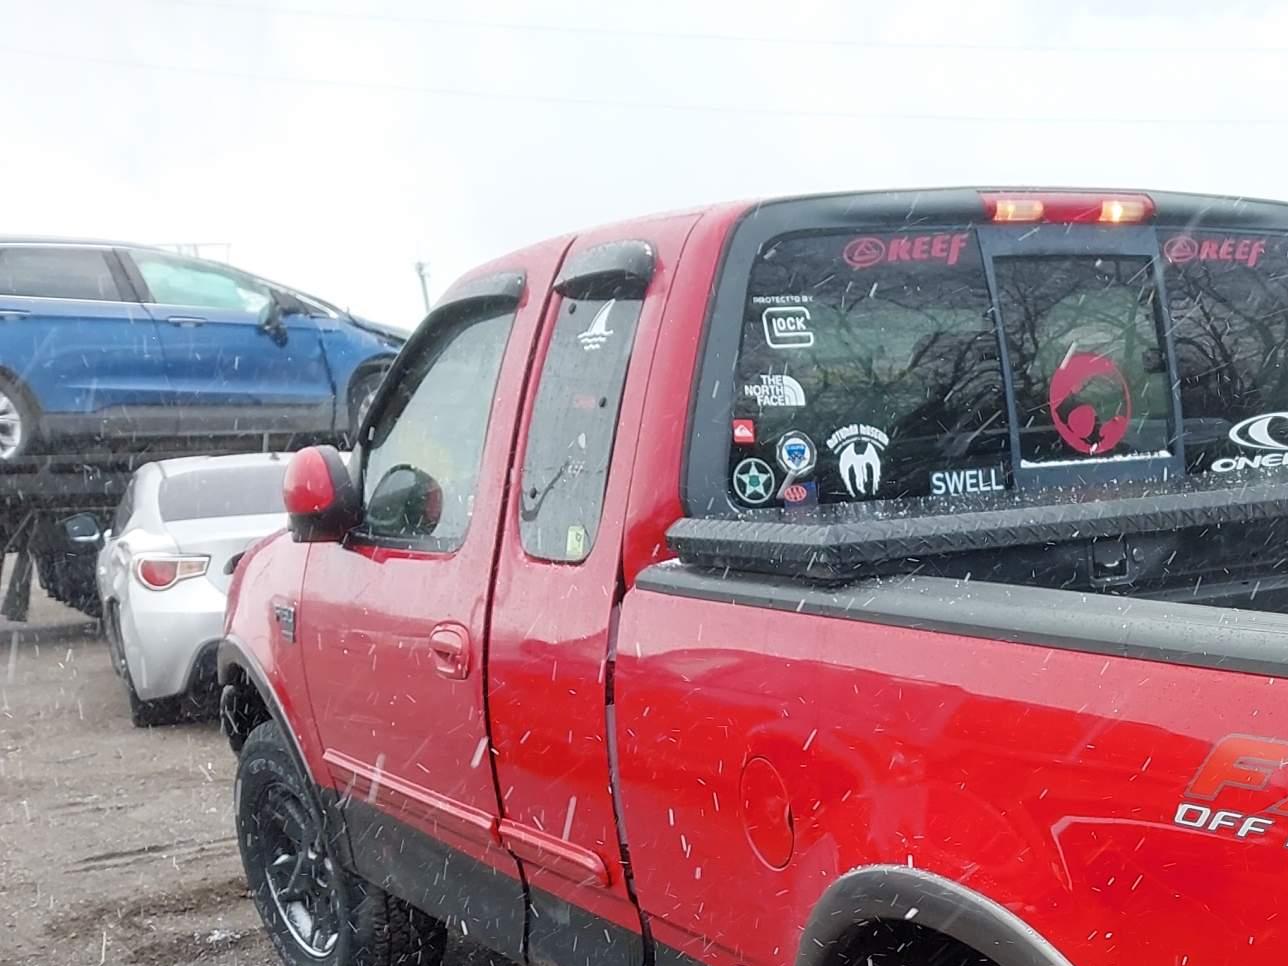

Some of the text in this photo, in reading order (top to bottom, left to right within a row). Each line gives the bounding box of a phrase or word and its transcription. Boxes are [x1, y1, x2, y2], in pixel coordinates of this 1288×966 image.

[887, 233, 969, 265] REEF
[1200, 239, 1266, 268] REEF
[744, 384, 784, 396] NORTH
[760, 374, 784, 385] THE
[757, 395, 785, 406] FACE
[931, 468, 1005, 495] SWELL
[1174, 803, 1275, 838] OFF
